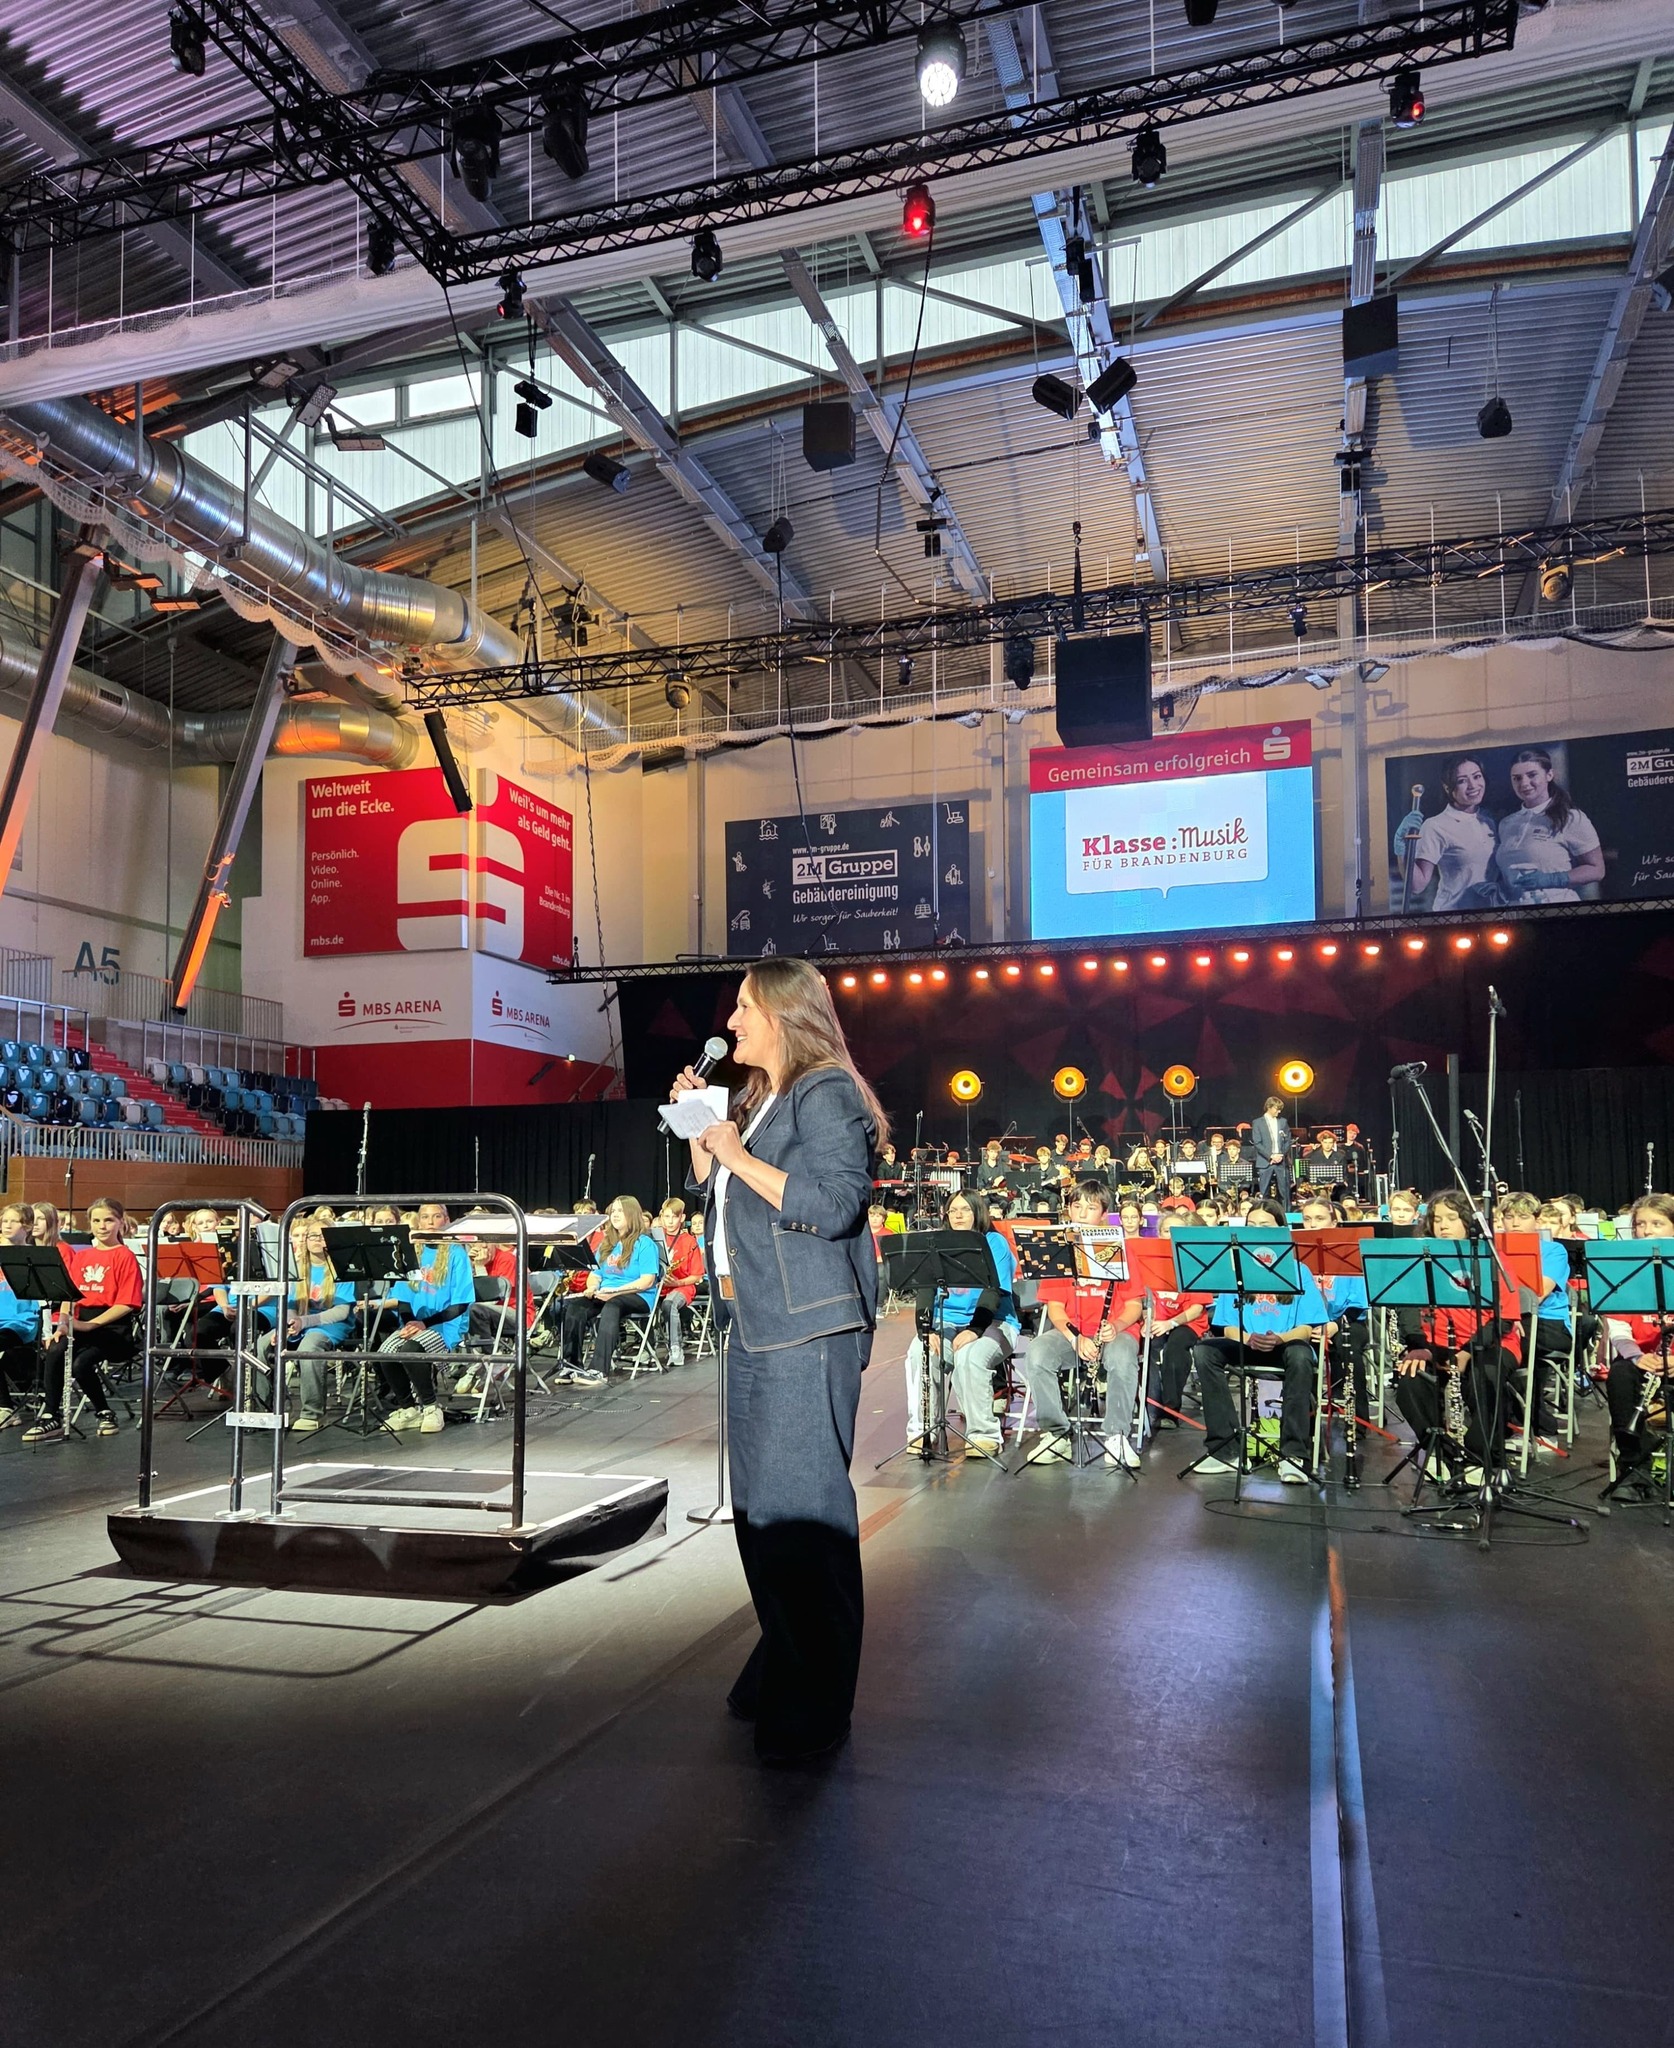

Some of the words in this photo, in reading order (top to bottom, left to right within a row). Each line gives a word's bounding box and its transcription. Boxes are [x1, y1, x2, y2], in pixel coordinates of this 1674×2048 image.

[1048, 762, 1148, 782] Gemeinsam
[1154, 748, 1250, 774] erfolgreich
[1630, 760, 1650, 770] 2M
[311, 779, 371, 798] Weltweit
[312, 806, 333, 818] um
[336, 801, 357, 816] die
[360, 798, 395, 814] Ecke.
[509, 787, 534, 812] Weil's
[536, 808, 549, 820] um
[550, 812, 571, 831] mehr
[517, 814, 531, 831] als
[531, 822, 550, 841] Geld
[551, 833, 571, 852] geht.
[311, 848, 359, 861] Persönlich.
[792, 842, 849, 854] www.m-gruppe.de
[796, 862, 823, 877] 2M
[829, 859, 894, 875] Gruppe
[1083, 858, 1113, 871] FÜR
[1121, 849, 1248, 868] BRANDENBURG
[1641, 854, 1662, 865] Wir
[311, 865, 339, 875] Video.
[311, 879, 342, 889] Online.
[1631, 871, 1650, 887] für
[311, 894, 330, 905] App.
[793, 883, 898, 904] Gebäudereinigung
[793, 913, 808, 923] Wir
[837, 910, 851, 924] für
[854, 907, 899, 919] Sauberkeit!
[310, 934, 344, 946] mbs.de
[74, 941, 121, 985] A5
[362, 1002, 391, 1016] MBS
[395, 1000, 442, 1014] ARENA
[506, 1006, 524, 1022] MBS
[524, 1011, 551, 1028] ARENA
